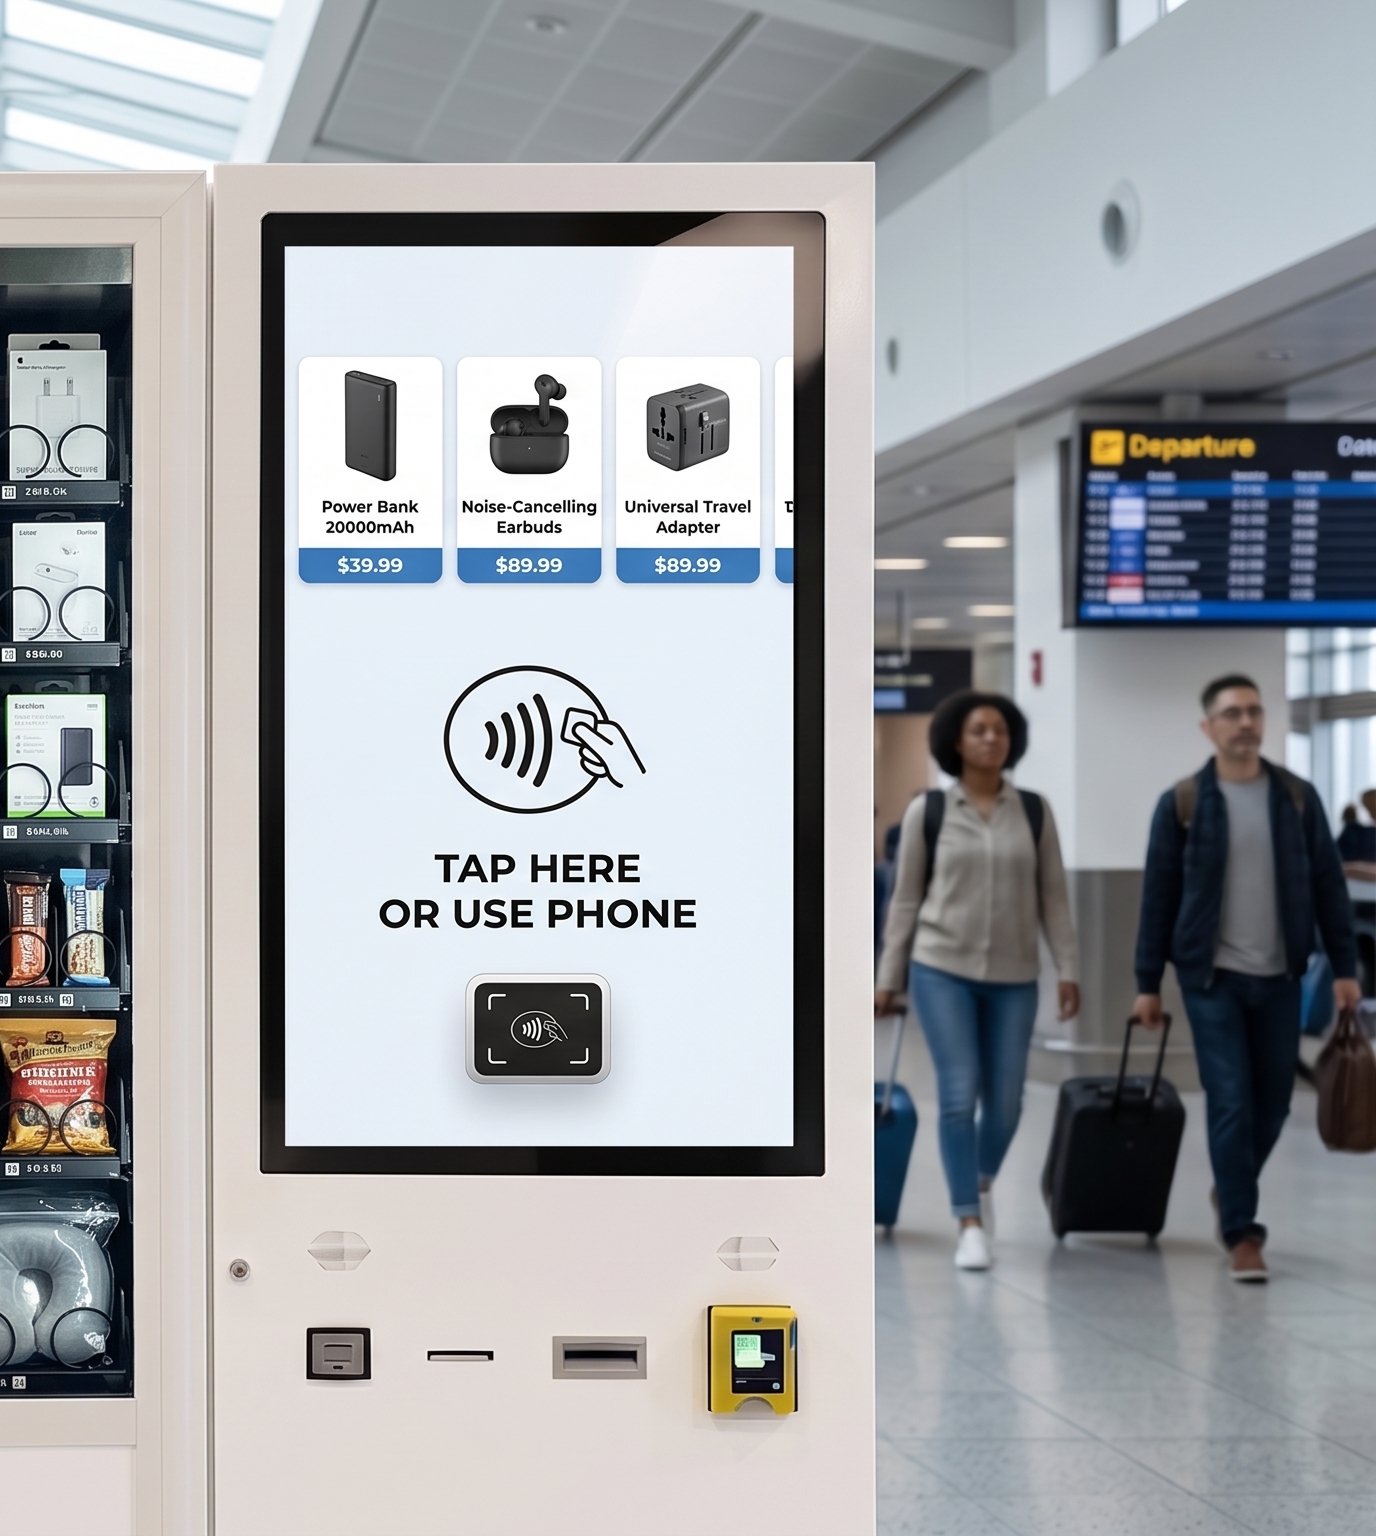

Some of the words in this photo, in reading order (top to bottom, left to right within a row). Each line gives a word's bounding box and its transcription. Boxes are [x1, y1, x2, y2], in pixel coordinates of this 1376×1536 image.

[1129, 434, 1256, 462] Departure
[322, 500, 373, 514] Power
[377, 499, 419, 514] Bank
[462, 498, 598, 517] Noise-Cancelling
[625, 499, 699, 514] Universal
[703, 499, 752, 514] Travel
[325, 520, 415, 534] 20000mAh
[497, 519, 563, 534] Earbuds
[655, 519, 721, 537] Adapter
[337, 555, 404, 575] $39.99
[495, 555, 564, 575] $89.99
[654, 555, 722, 575] $89.99
[435, 854, 516, 883] TAP
[530, 854, 641, 883] HERE
[379, 898, 440, 929] OR
[454, 898, 534, 929] USE
[548, 898, 697, 929] PHONE
